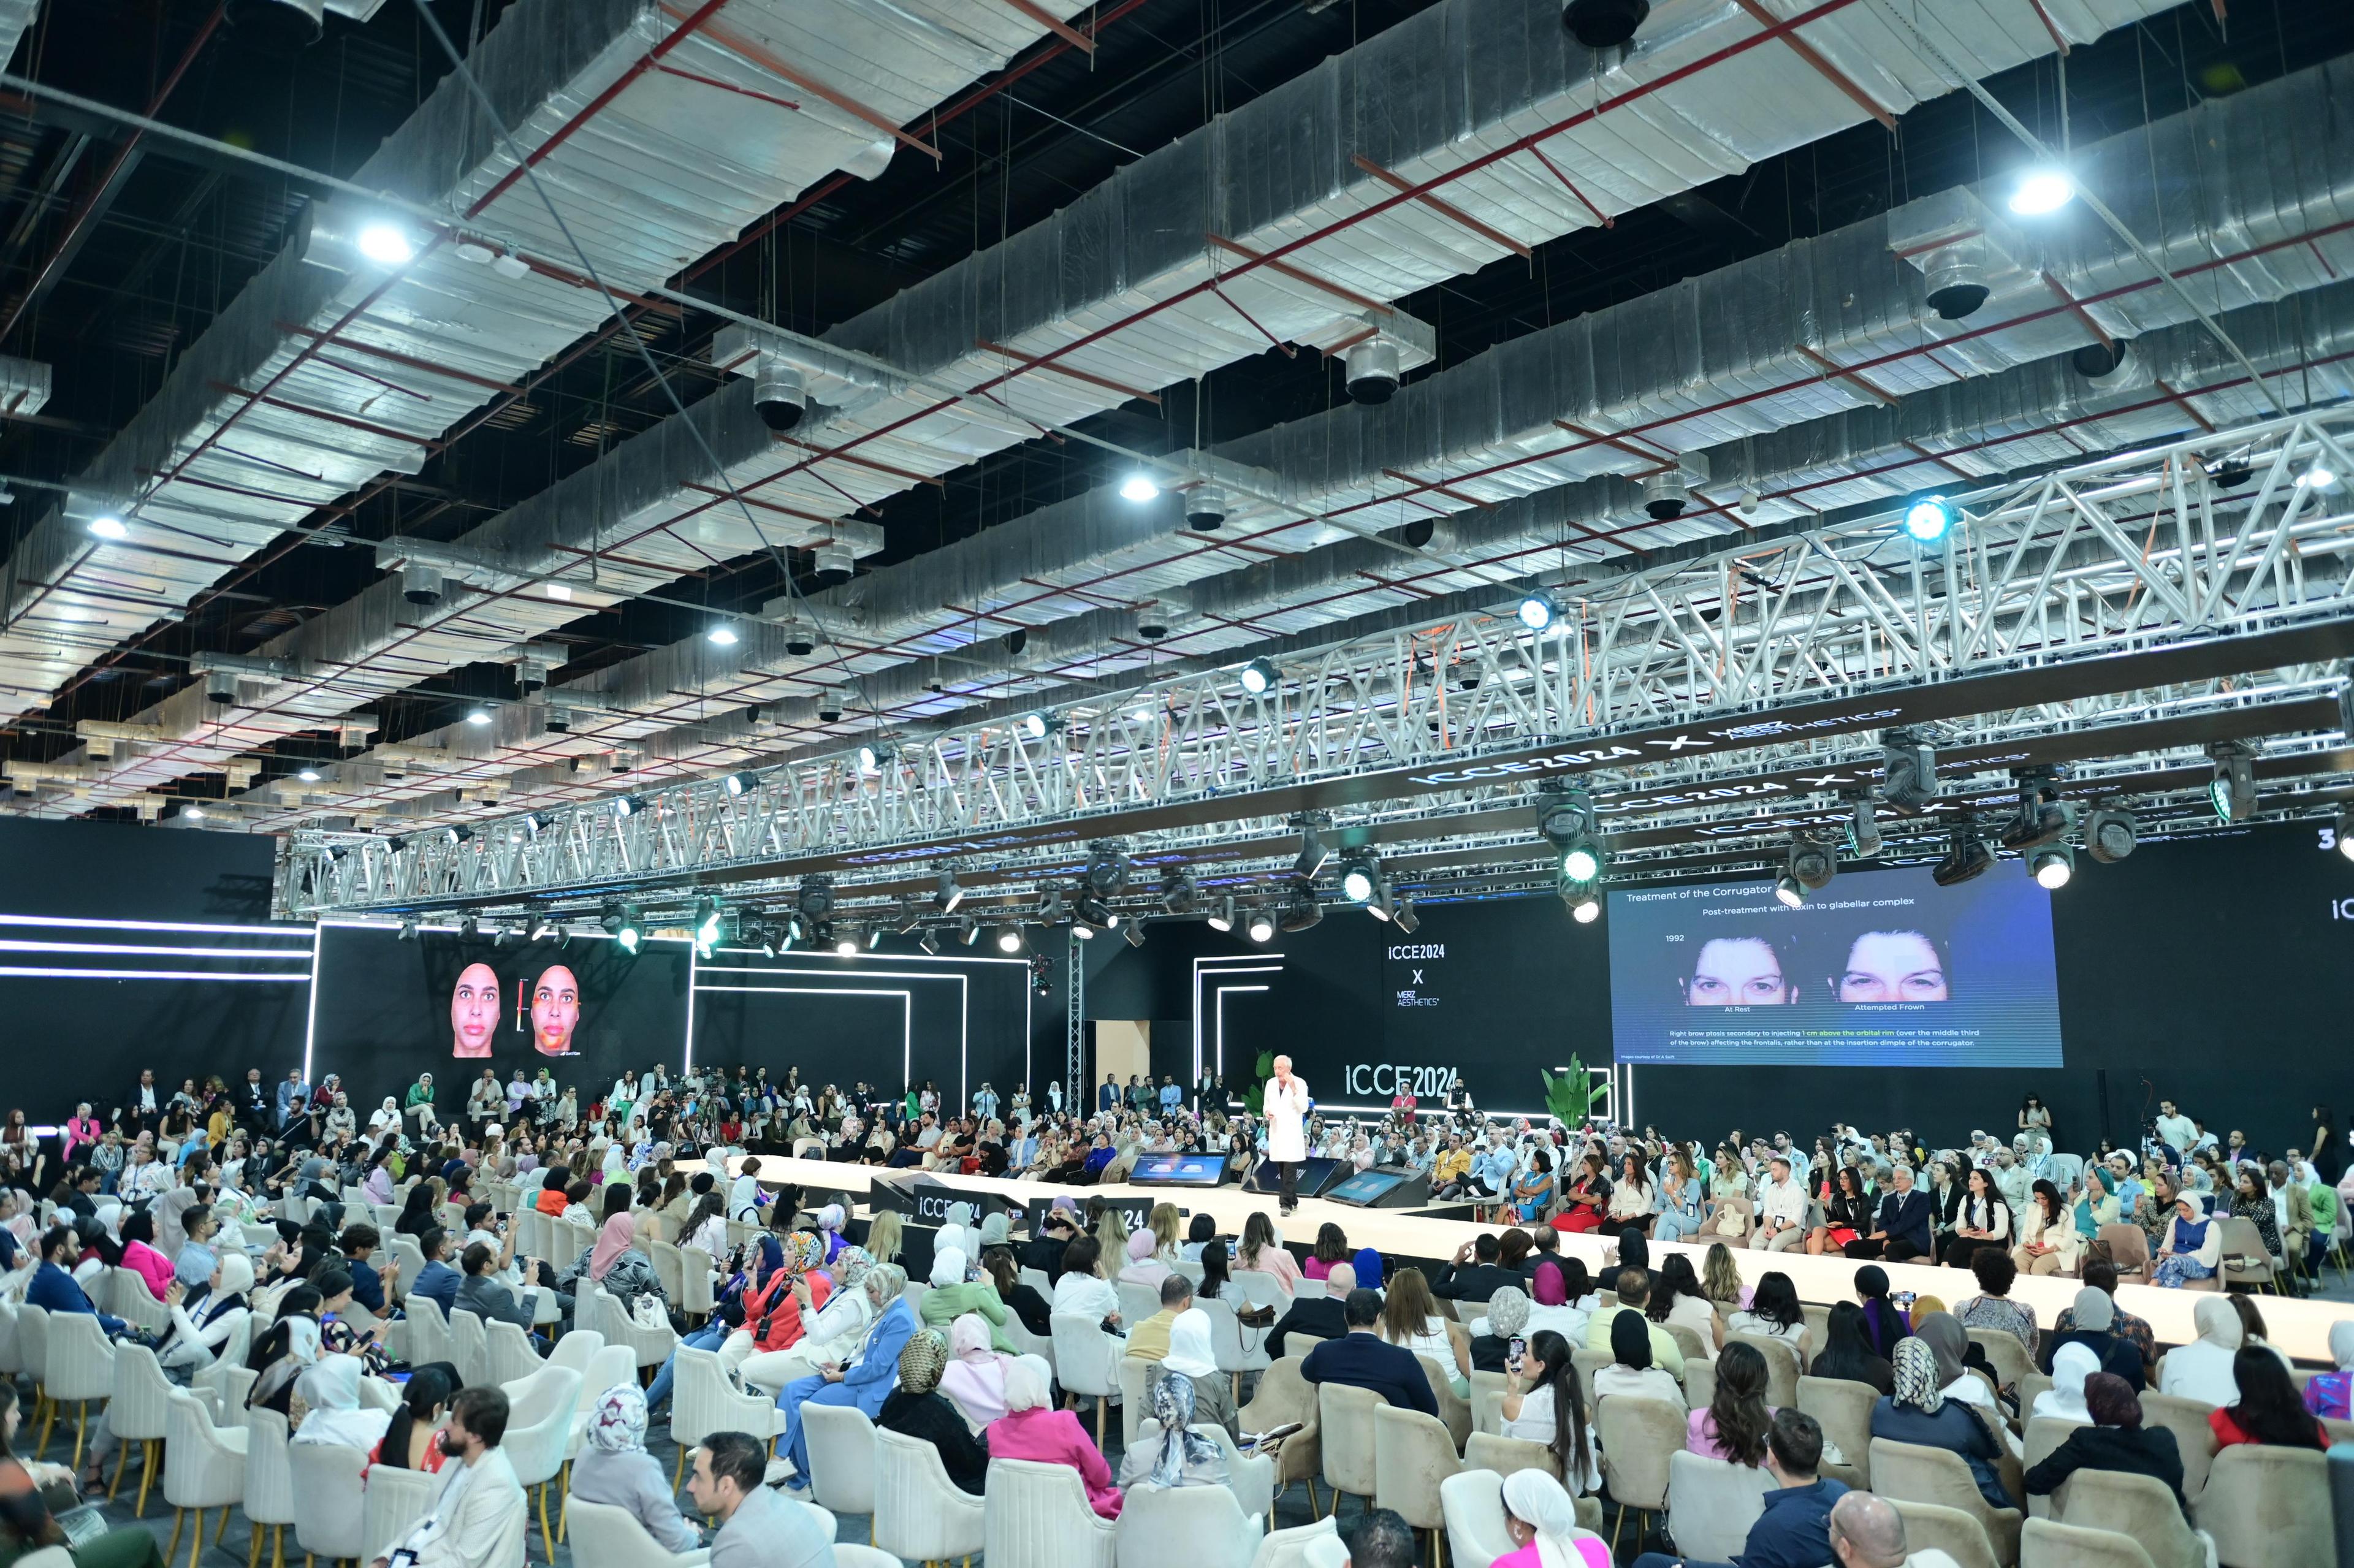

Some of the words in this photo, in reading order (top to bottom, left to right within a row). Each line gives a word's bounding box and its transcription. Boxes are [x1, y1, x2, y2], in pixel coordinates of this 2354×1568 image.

[1408, 745, 1642, 785] ICCE2024
[1694, 809, 1897, 835] ICCE204
[1626, 889, 1677, 902] Treatment
[1680, 889, 1690, 899] of
[1693, 889, 1710, 898] the
[1713, 885, 1772, 896] Corrugator
[1702, 905, 1767, 916] Post-treatment
[1829, 900, 1870, 910] glabellar
[1873, 897, 1914, 908] complex
[1388, 944, 1445, 960] ICCE2024
[1412, 969, 1423, 984] X
[1346, 1064, 1457, 1097] ICCE2024
